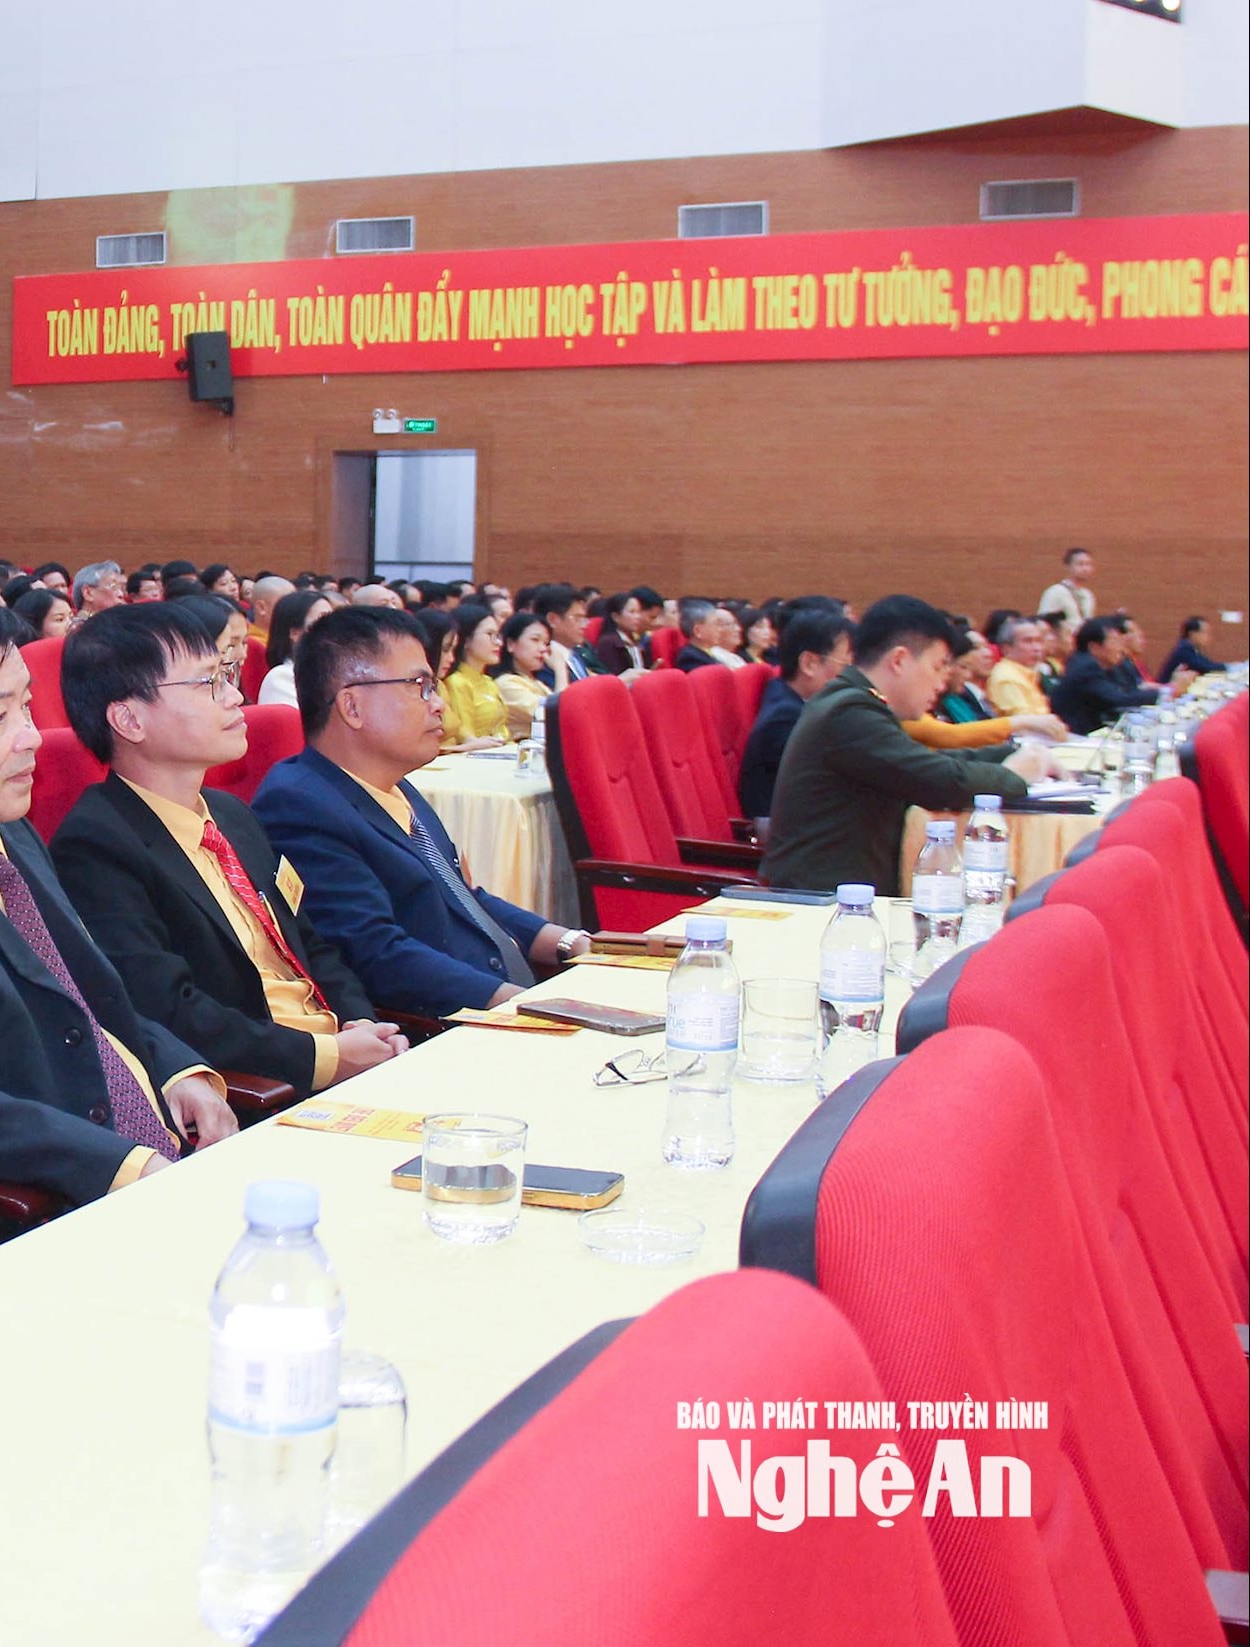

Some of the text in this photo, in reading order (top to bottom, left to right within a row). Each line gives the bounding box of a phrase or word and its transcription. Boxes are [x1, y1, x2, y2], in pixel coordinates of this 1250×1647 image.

[47, 299, 98, 357] TOÀN
[103, 290, 165, 358] ĐẢNG,
[231, 288, 281, 353] DÂN,
[287, 285, 346, 347] TOÀN
[350, 282, 412, 350] QUÂN
[417, 269, 464, 343] ĐẨY
[469, 286, 541, 353] MẠNH
[545, 283, 596, 350] HỌC
[600, 271, 649, 348] TẬP
[653, 268, 687, 334] VÀ
[691, 266, 748, 333] LÀM
[752, 274, 819, 331] THEO
[824, 267, 860, 329] TƯ
[862, 251, 961, 331] TƯỞNG,
[965, 265, 1025, 336] ĐẠO
[1029, 251, 1097, 328] ĐỨC,
[1102, 257, 1205, 320] PHONG
